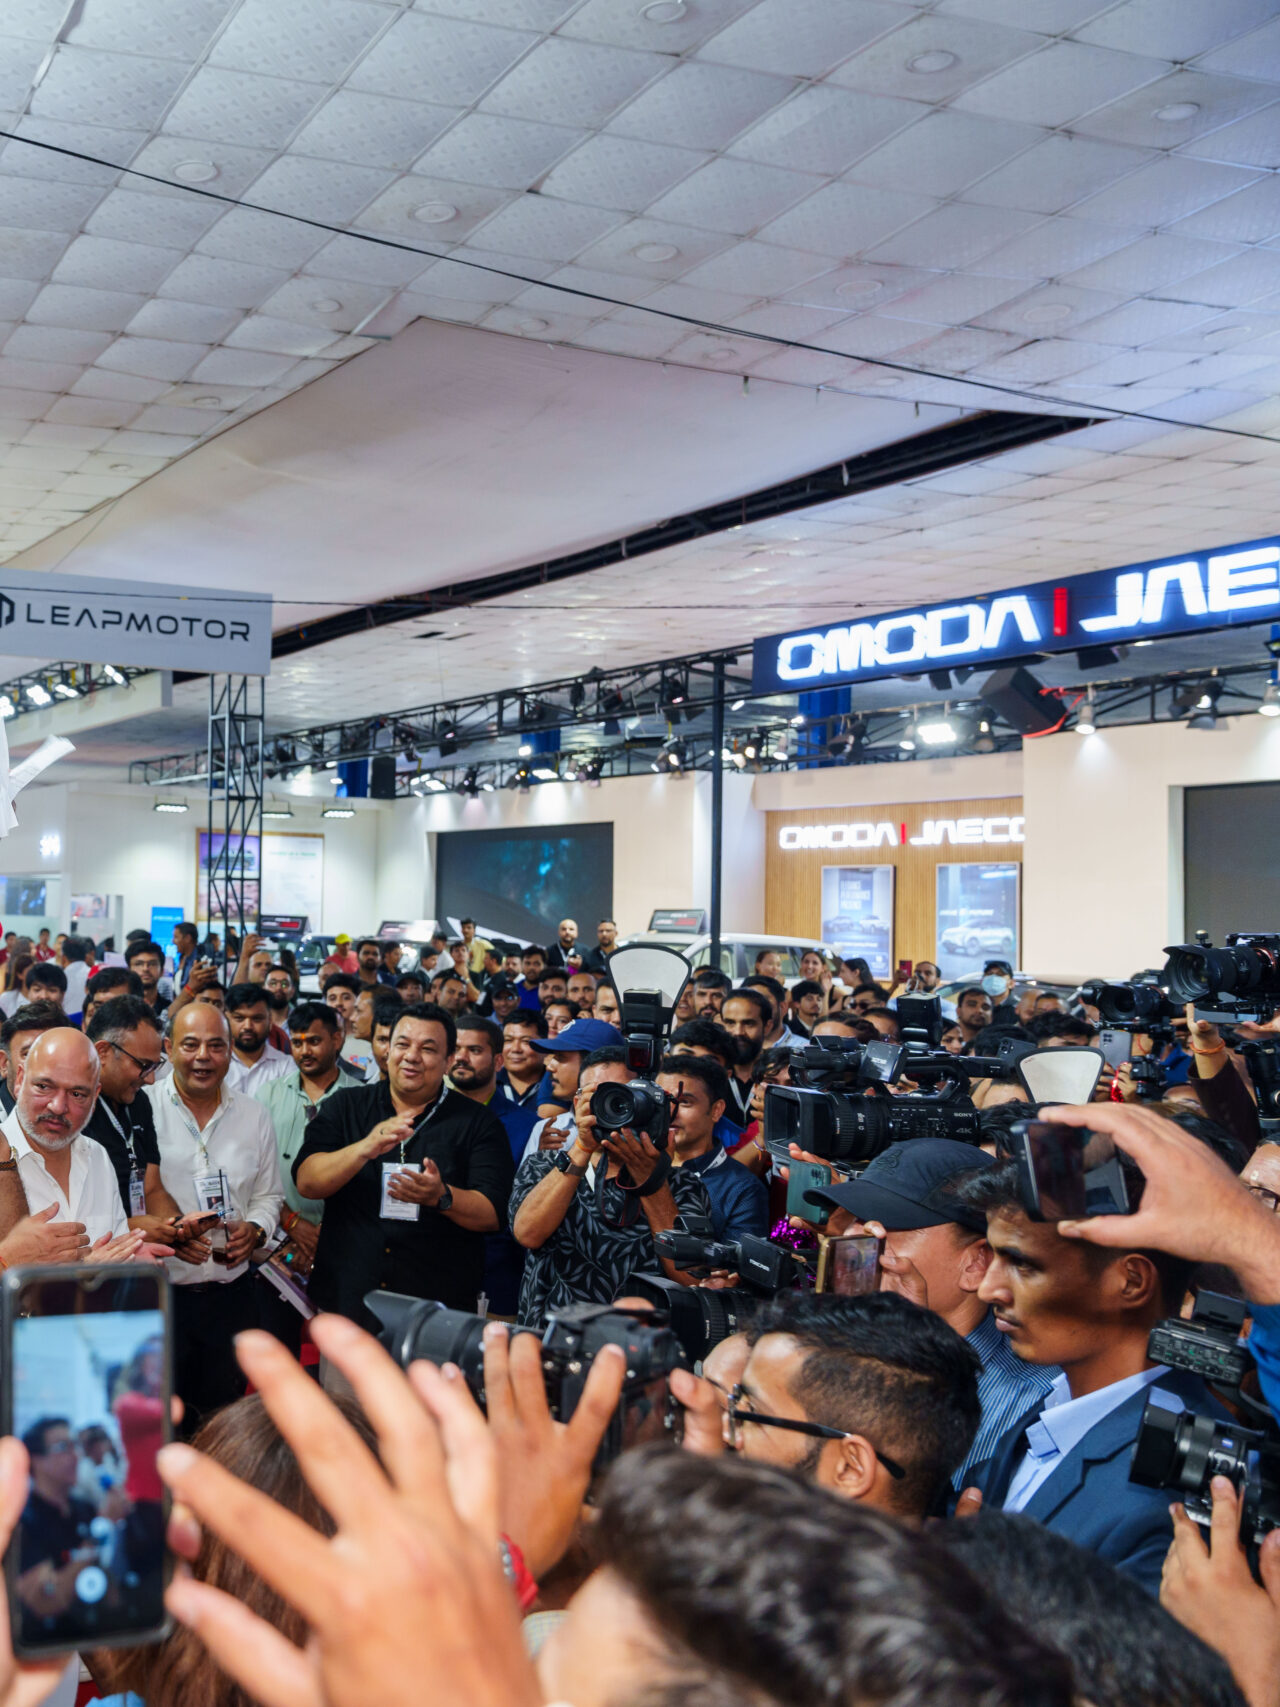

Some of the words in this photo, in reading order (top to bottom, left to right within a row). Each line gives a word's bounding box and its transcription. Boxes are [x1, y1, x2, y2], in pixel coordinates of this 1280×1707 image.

[26, 602, 250, 642] LEAPMOTOR
[776, 593, 1042, 682] OMODA
[779, 822, 898, 849] OMODA
[956, 1127, 973, 1135] 4K
